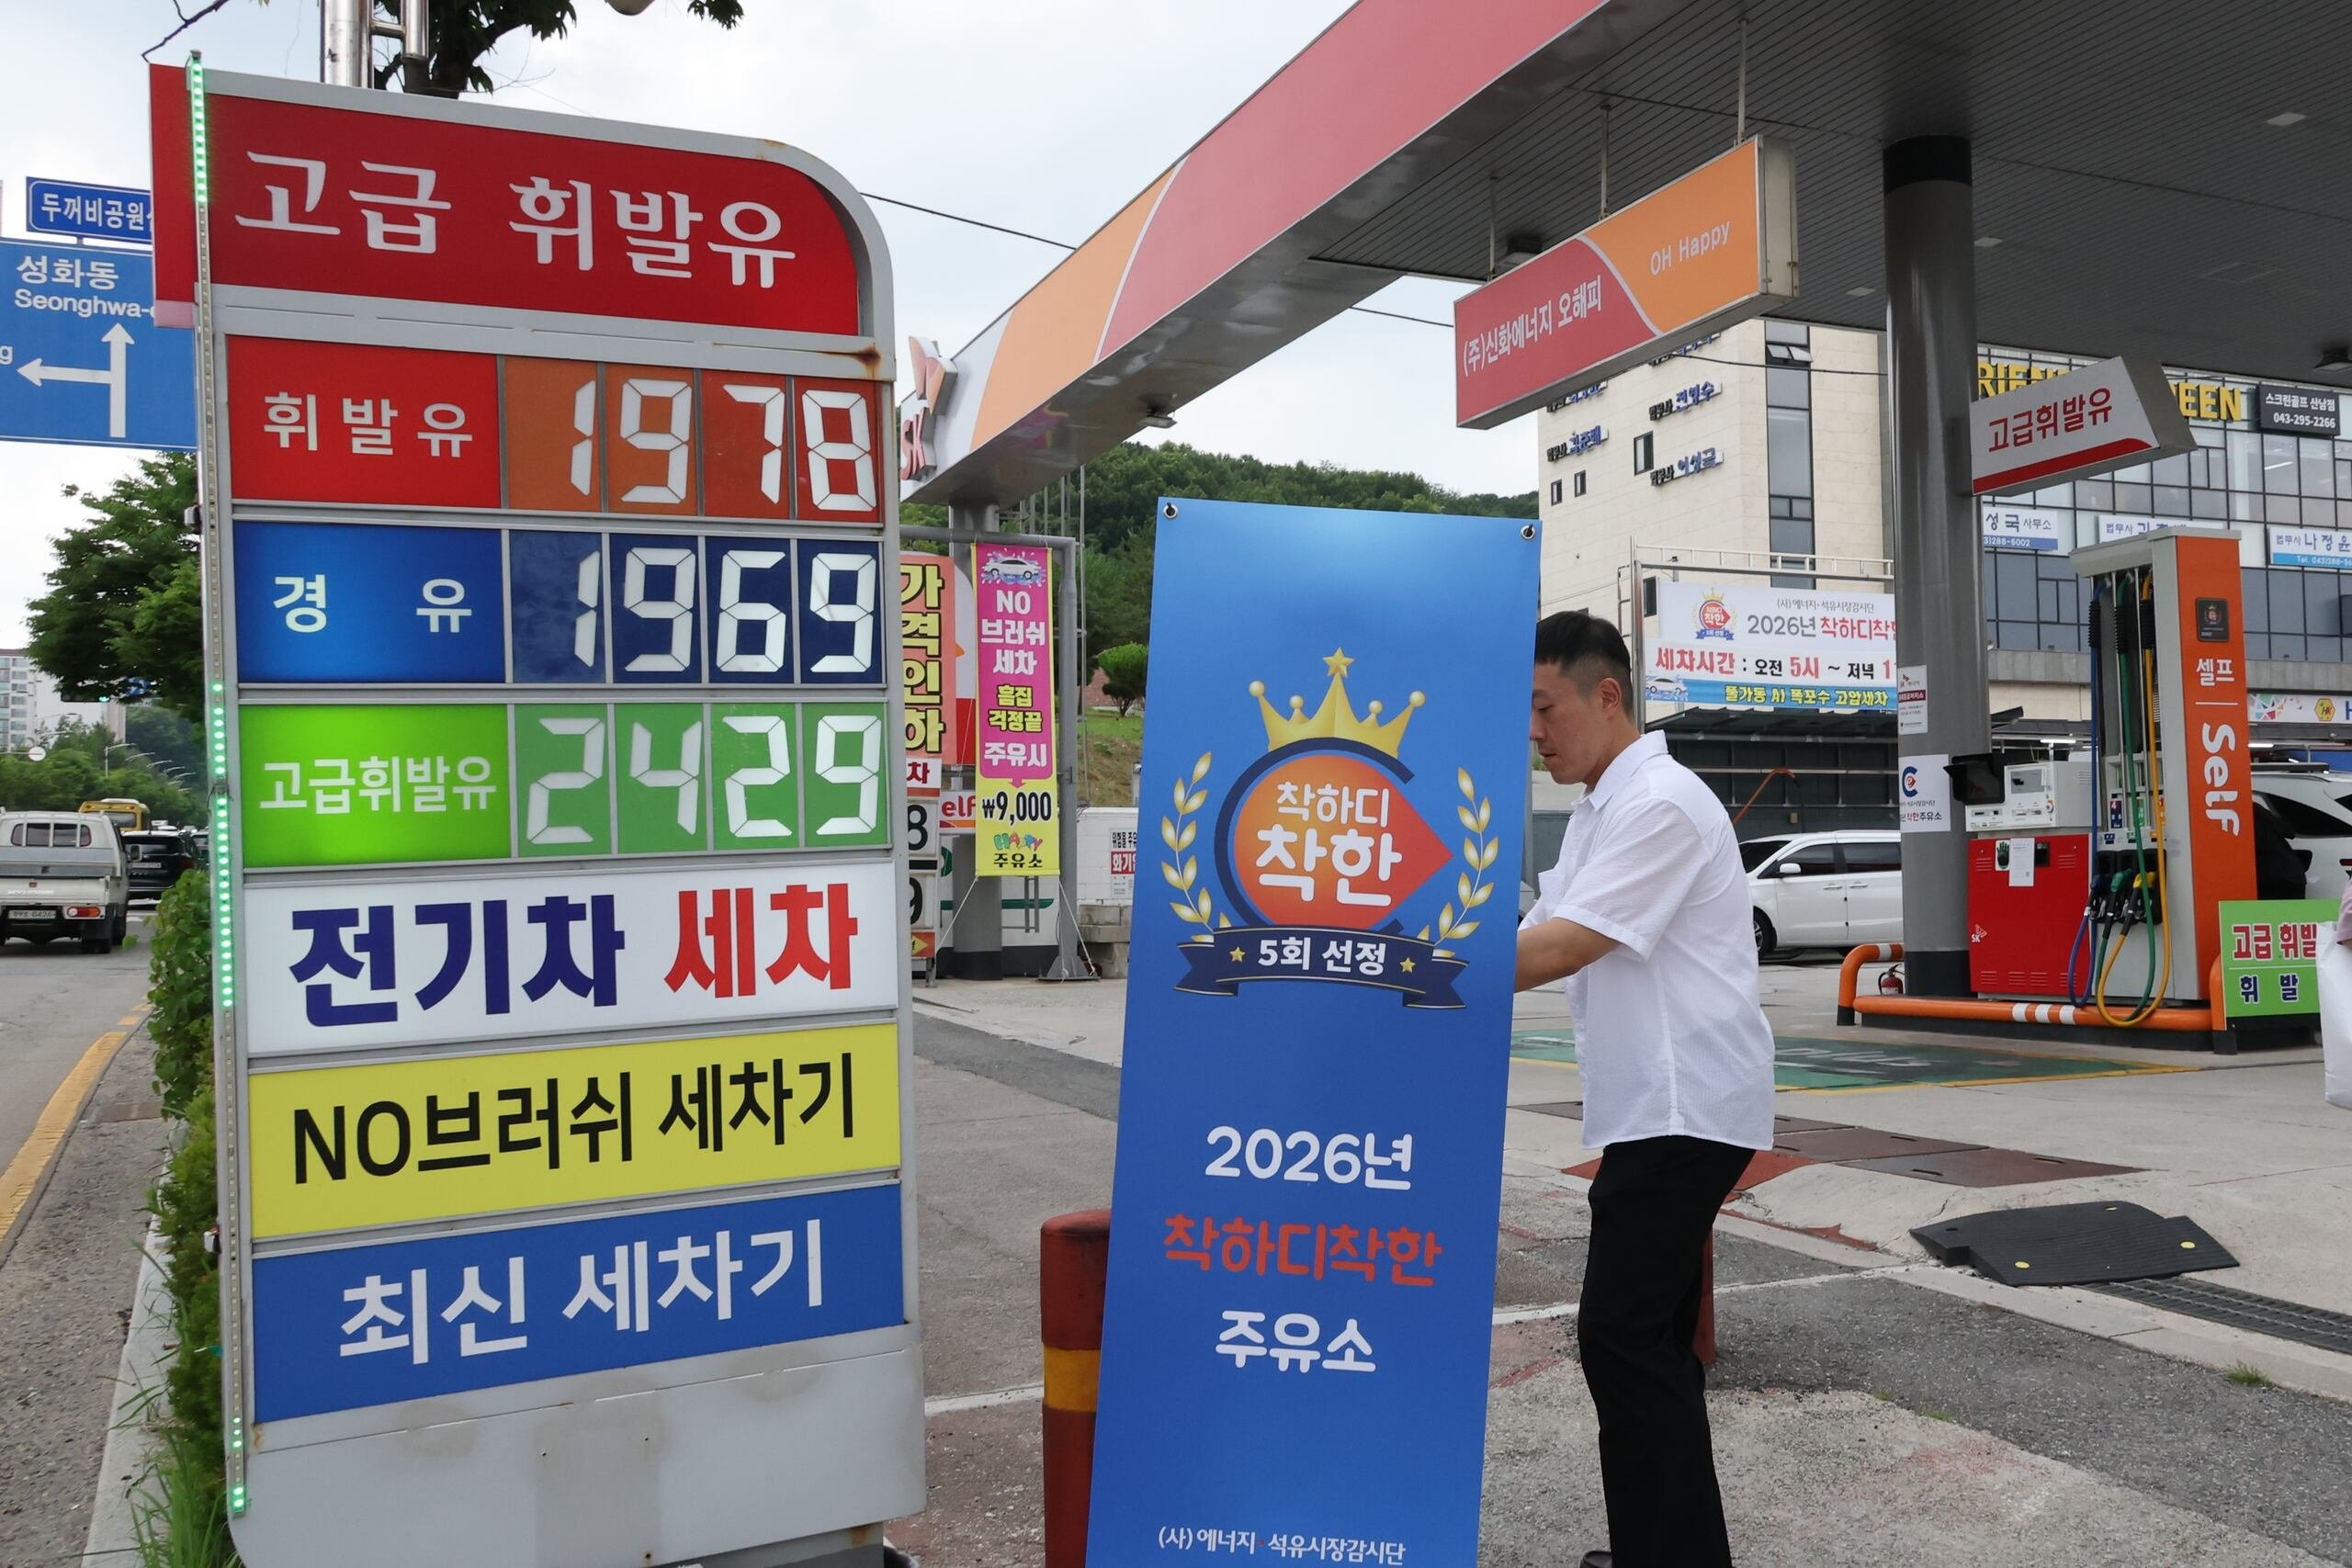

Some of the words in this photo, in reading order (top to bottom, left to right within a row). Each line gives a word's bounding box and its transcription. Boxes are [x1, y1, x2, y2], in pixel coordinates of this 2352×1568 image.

[235, 151, 451, 254] 고급
[509, 176, 796, 288] 휘발유
[1650, 245, 1672, 276] OH
[1679, 221, 1730, 262] Happy
[17, 255, 119, 290] 성화동
[1463, 300, 1553, 378] (주)신화에너지
[1558, 275, 1601, 328] 오해피
[2169, 382, 2242, 422] EEN
[2266, 392, 2309, 408] 스크린골프
[1988, 388, 2113, 453] 고급휘발유
[2273, 412, 2335, 428] 043-295-2266
[571, 378, 876, 512] 1978
[2023, 518, 2052, 530] 사무소
[574, 547, 876, 673] 1969
[996, 590, 1031, 615] NO
[981, 618, 1046, 646] 브러쉬
[1747, 615, 1816, 637] 2026년
[992, 649, 1037, 675] 세차
[1656, 647, 1735, 675] 세차시간
[1755, 659, 1782, 677] 오전
[1790, 657, 1819, 679] 5시
[1848, 662, 1874, 680] 저녁
[2196, 658, 2235, 686] 셀프
[1771, 688, 1785, 703] AI
[1791, 689, 1830, 705] 폭포수
[1835, 690, 1889, 706] 고압세차
[988, 709, 1043, 732] 걱정끝
[983, 742, 1047, 767] 주유시
[259, 754, 497, 815] 고급휘발유
[526, 715, 882, 845] 2429
[982, 791, 1051, 826] ₩9,000
[1276, 781, 1389, 828] 착하디
[993, 852, 1044, 868] 주유소
[1255, 824, 1402, 907] 착한
[289, 894, 626, 1028] 전기차
[664, 883, 858, 998] 세차
[1258, 937, 1311, 970] 5회
[1321, 941, 1386, 976] 선정
[2233, 924, 2272, 959] 고급
[294, 1072, 632, 1184] NO브러쉬
[659, 1053, 854, 1153] 세차기
[1204, 1125, 1413, 1190] 2026년
[1163, 1213, 1442, 1286] 착하디착한
[340, 1256, 527, 1365] 최신
[562, 1219, 822, 1332] 세차기
[1215, 1310, 1376, 1373] 주유소
